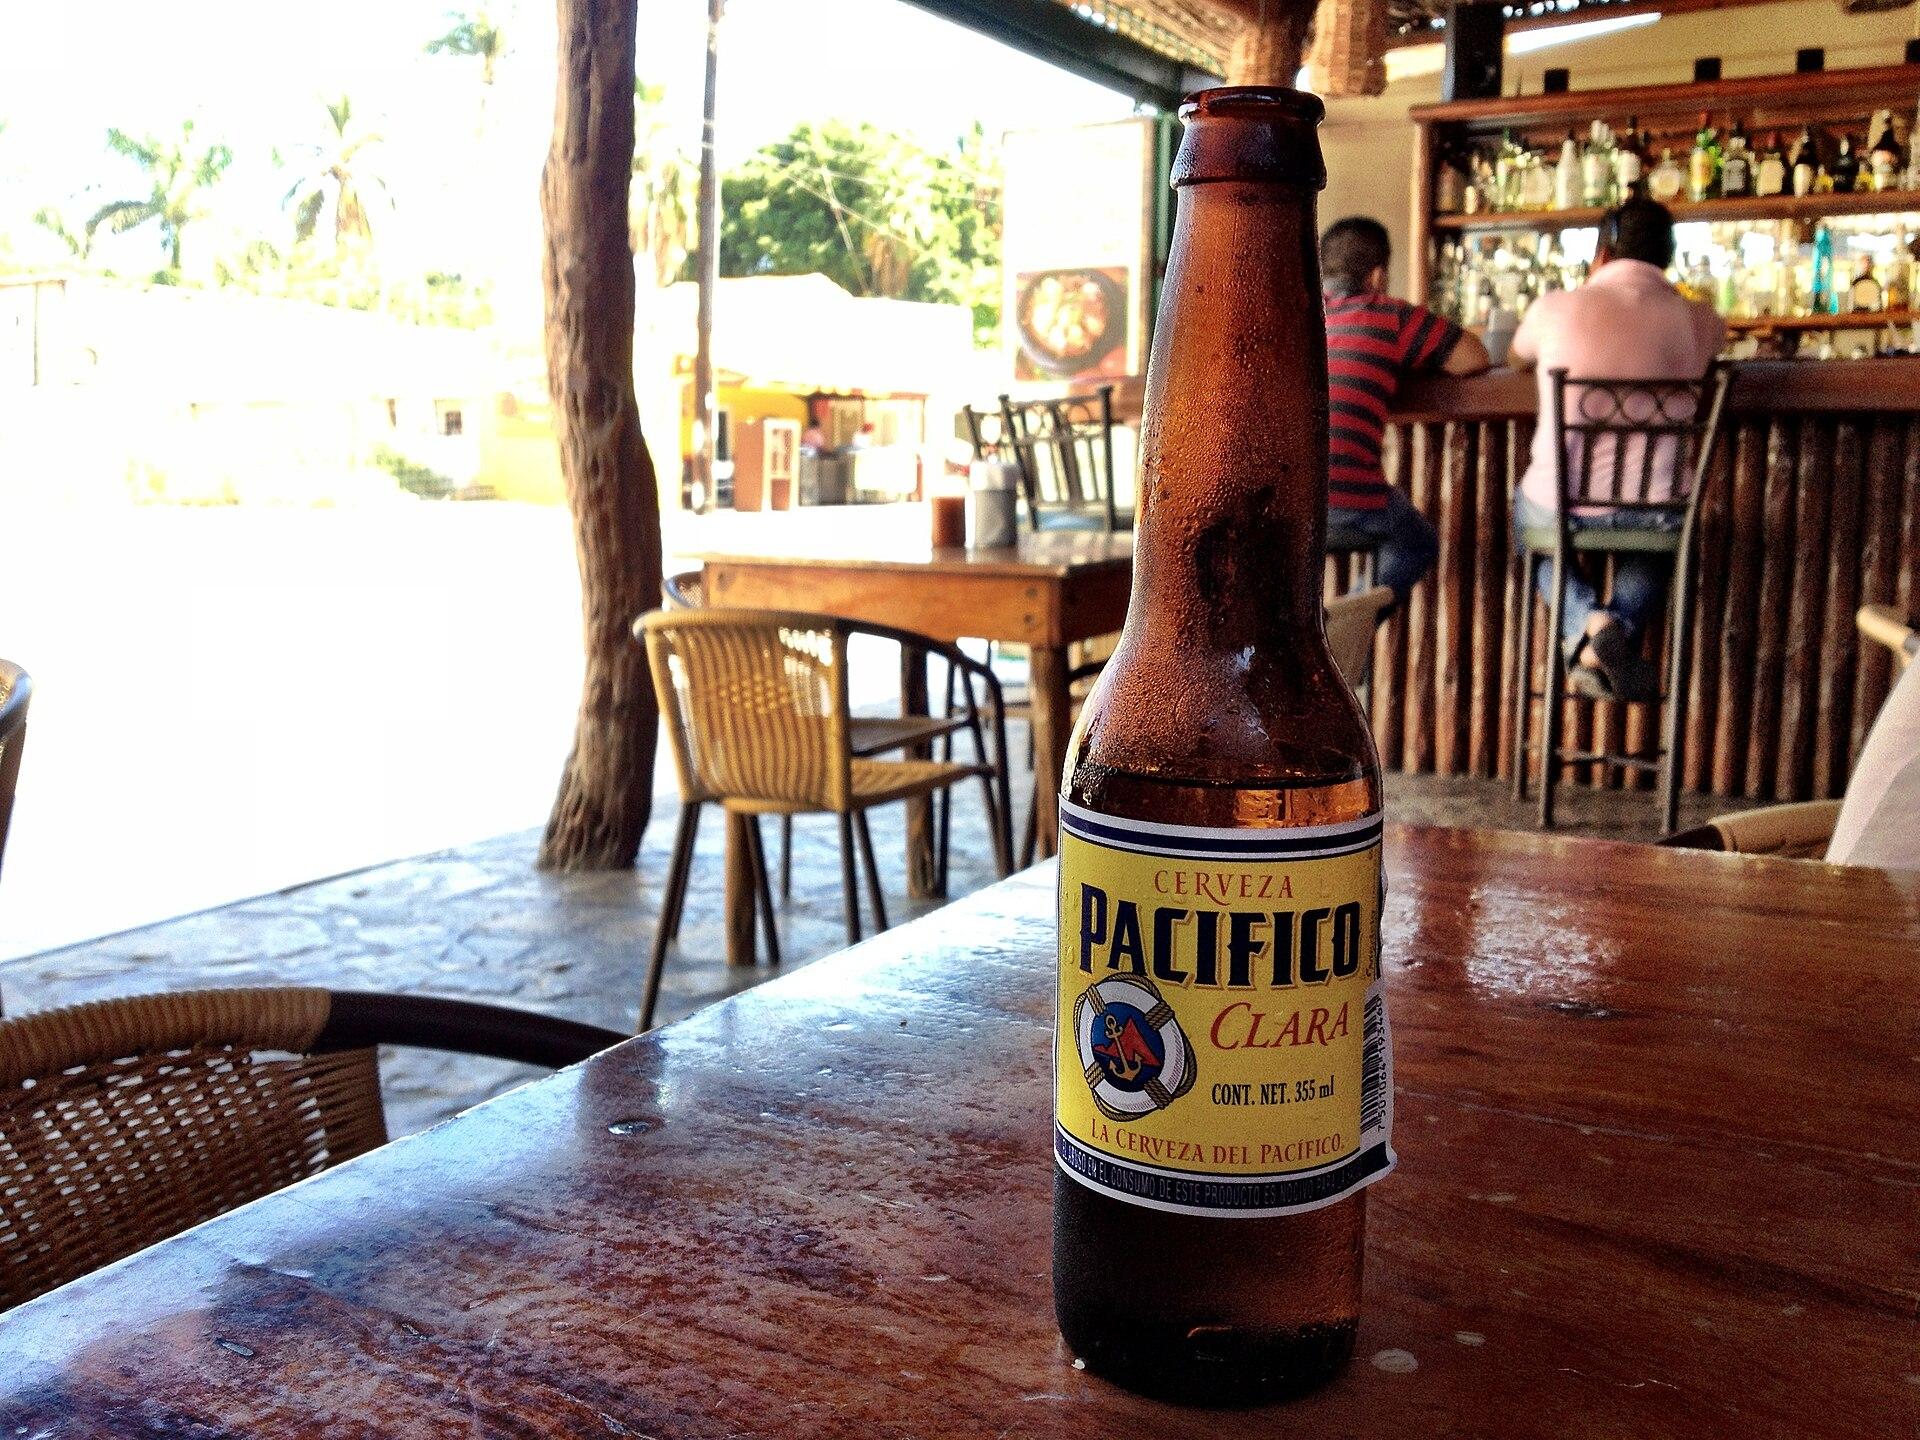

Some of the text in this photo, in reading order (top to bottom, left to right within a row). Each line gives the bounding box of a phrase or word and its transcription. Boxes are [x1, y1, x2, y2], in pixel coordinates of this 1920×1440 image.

[1154, 870, 1294, 906] CERVEZA
[1079, 883, 1362, 990] PACIFICO
[1210, 1001, 1349, 1050] CLARA
[1211, 1075, 1335, 1106] CONT. NET. 355 ml
[1377, 1062, 1387, 1118] 501064
[1091, 1118, 1345, 1165] LA CERVEZA DEL PACÍFICO.
[1377, 1124, 1386, 1132] 7
[1099, 1162, 1108, 1183] EL
[1111, 1166, 1156, 1196] CONSUMO
[1159, 1178, 1171, 1199] DE
[1175, 1180, 1200, 1203] ESTE
[1204, 1184, 1260, 1206] PRODUCTO
